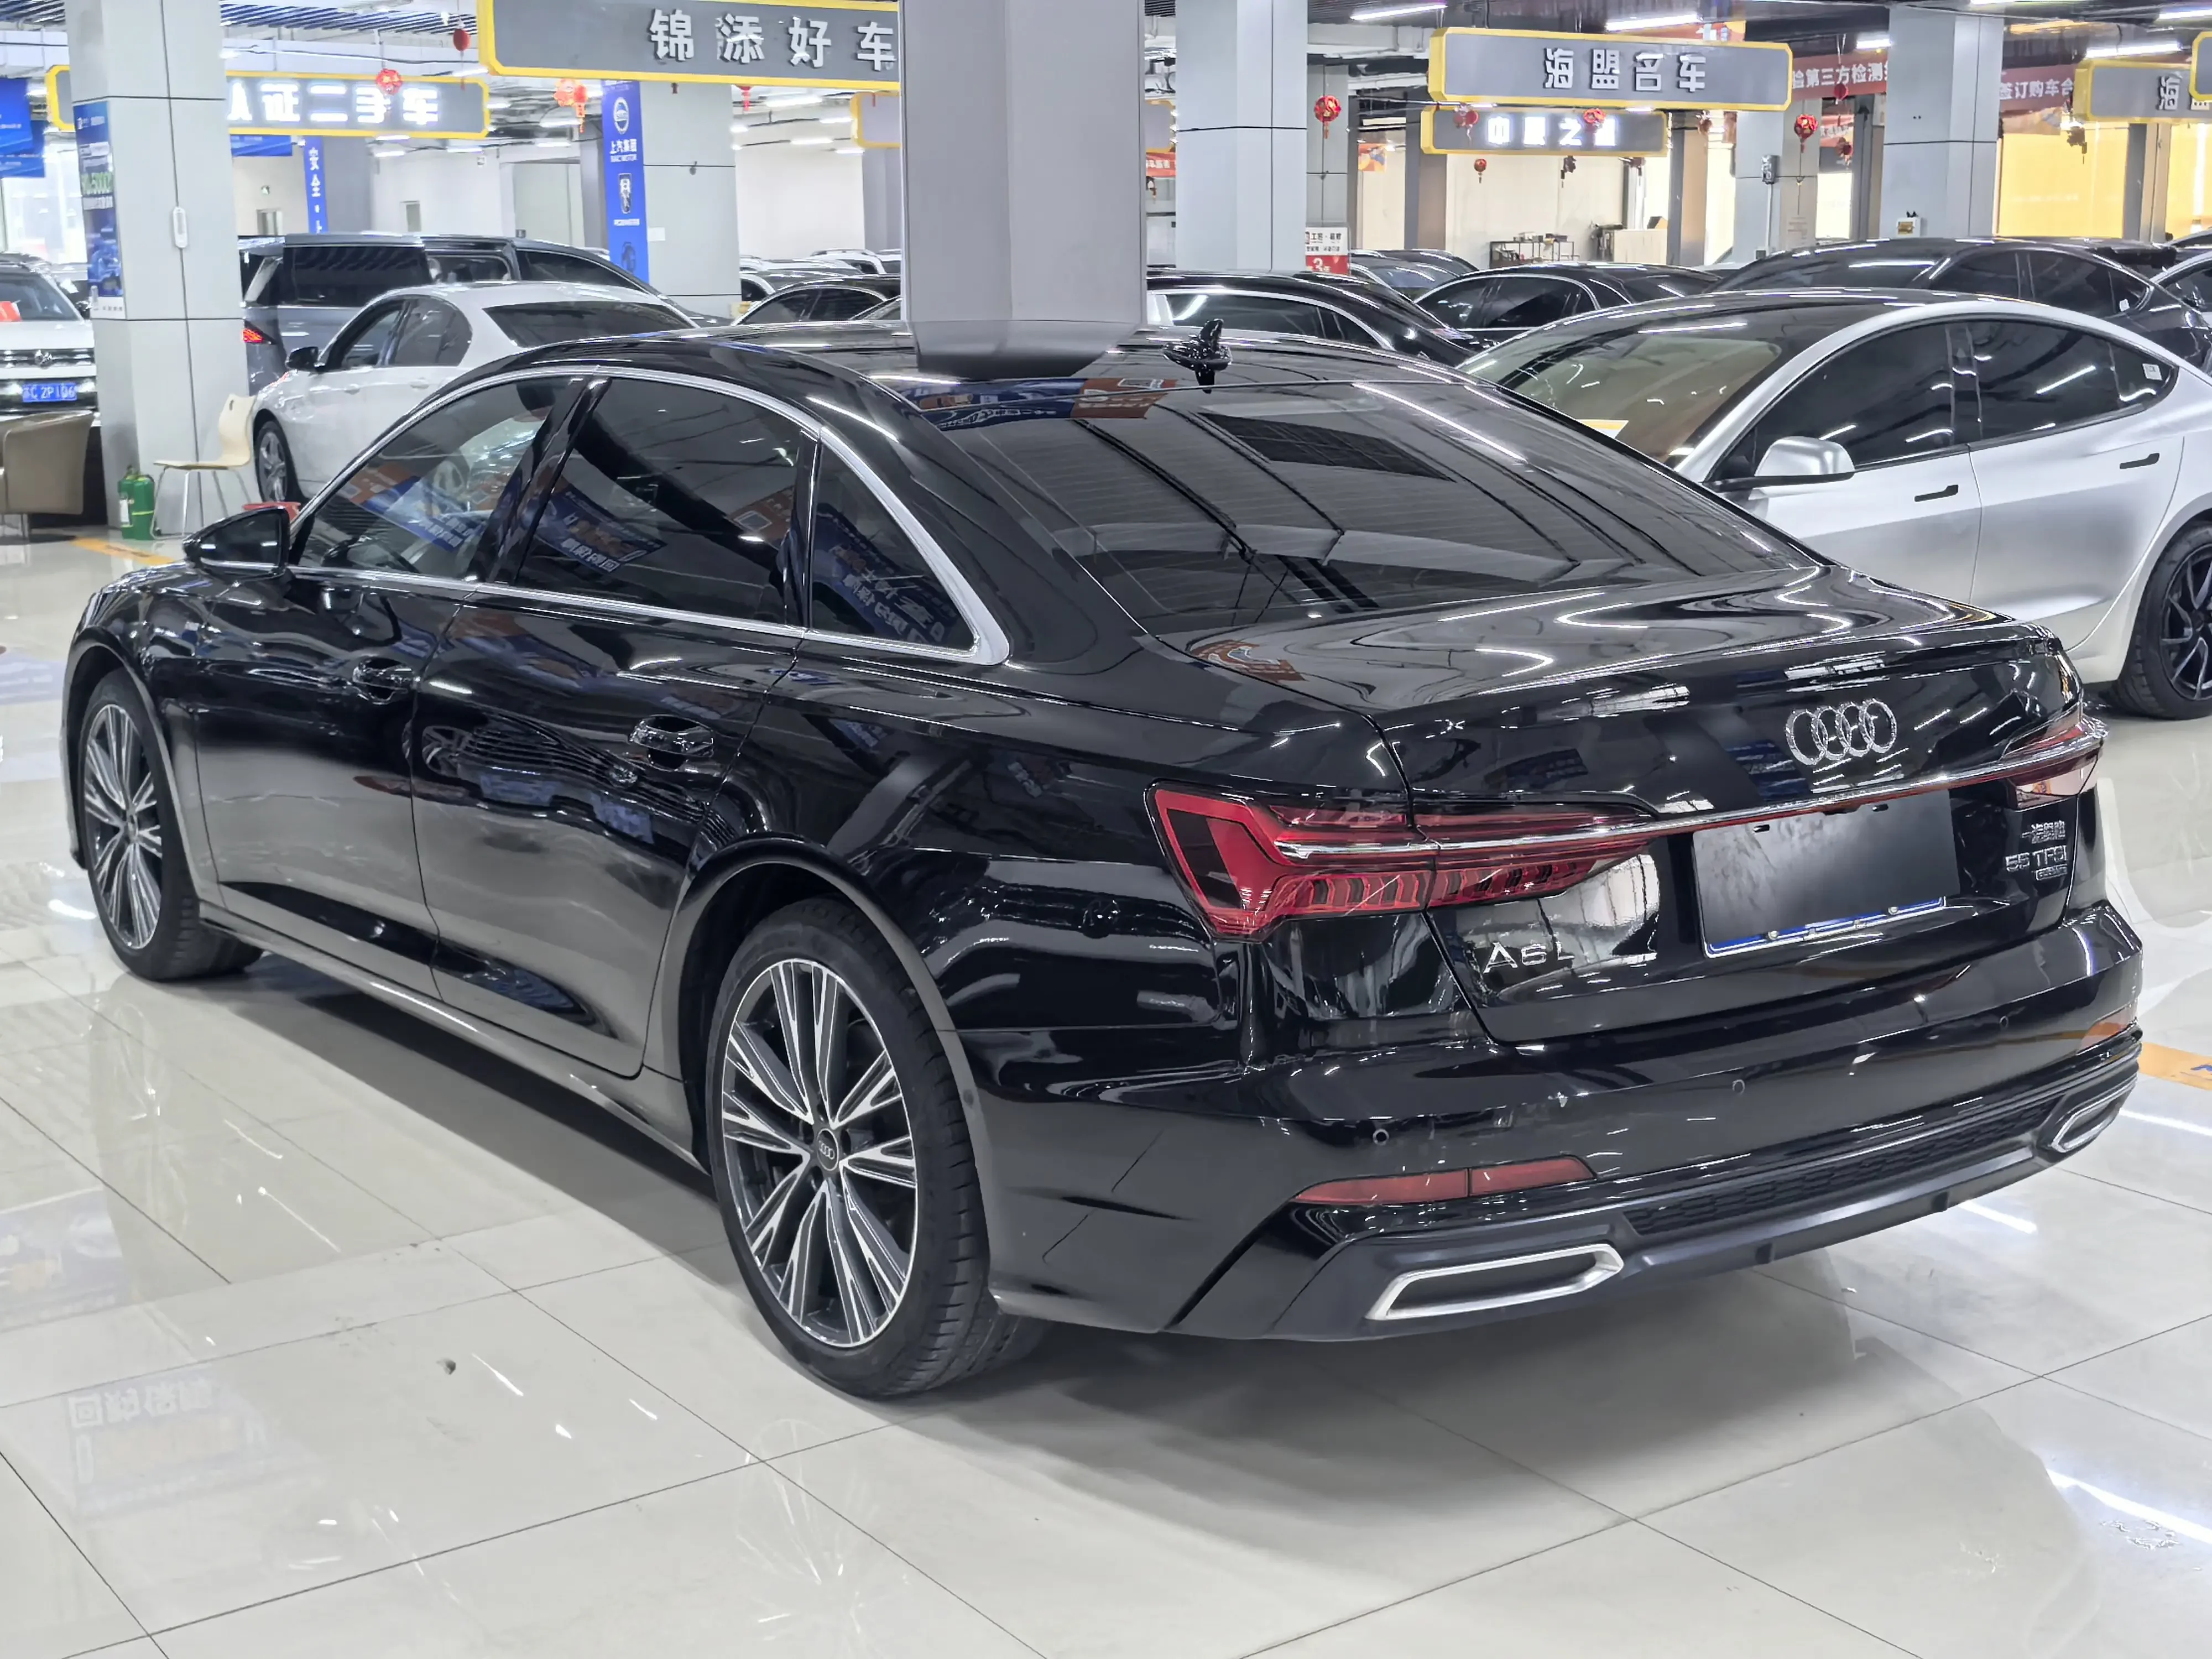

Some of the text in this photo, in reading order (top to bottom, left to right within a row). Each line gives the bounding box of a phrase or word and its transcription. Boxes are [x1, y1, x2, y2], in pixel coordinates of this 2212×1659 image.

[650, 8, 896, 71] 锦添好车
[1545, 47, 1706, 92] 海盟名车
[1793, 61, 1888, 88] 第三方检测
[2158, 75, 2210, 110] 海
[1484, 941, 1574, 973] A6L
